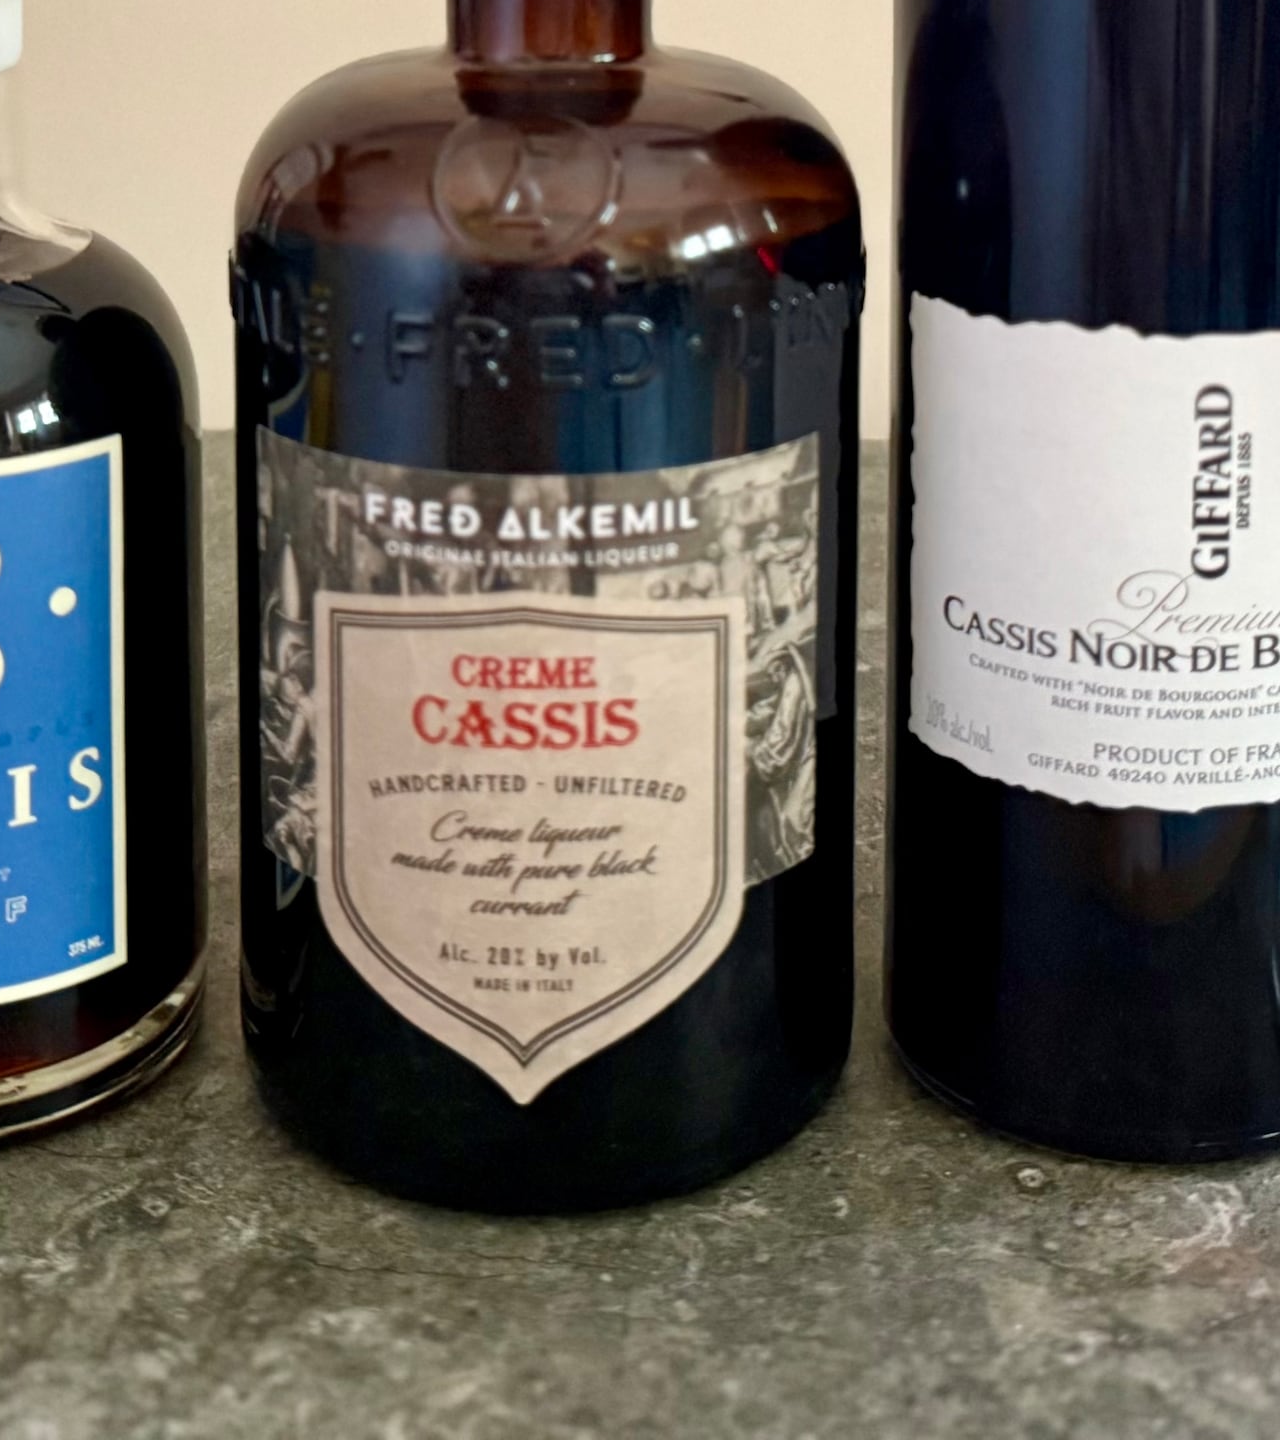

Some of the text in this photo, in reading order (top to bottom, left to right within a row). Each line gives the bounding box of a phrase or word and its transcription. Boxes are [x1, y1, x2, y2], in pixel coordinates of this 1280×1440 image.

[1191, 382, 1233, 579] GIFFARD
[1237, 474, 1251, 529] DEPUIS
[384, 540, 680, 568] ORIGINAL ITALIAN LIQUEUR
[942, 594, 1058, 658] CASSIS
[1069, 628, 1179, 673] NOIR
[1190, 644, 1240, 673] DE
[451, 654, 597, 690] CREME
[969, 652, 1028, 682] CRAFTED
[1032, 673, 1073, 691] WITH
[1132, 688, 1153, 701] DE
[412, 694, 640, 750] CASSIS
[1050, 695, 1090, 711] RICH
[1094, 702, 1142, 718] FRUIT
[1146, 707, 1205, 720] FLAVOR
[1209, 707, 1243, 719] AND
[1027, 752, 1100, 778] GIFFARD
[1107, 768, 1167, 785] 49240
[1093, 742, 1203, 766] PRODUCT
[1209, 747, 1239, 766] OF
[369, 774, 527, 799] HANDCRAFTED
[554, 775, 687, 804] UNFILTERED
[430, 810, 624, 858] Creme liqueur
[391, 845, 658, 895] made with pure black
[469, 889, 591, 916] currant
[536, 948, 559, 971] by
[474, 977, 510, 991] MADE
[536, 979, 573, 992] ITALY
